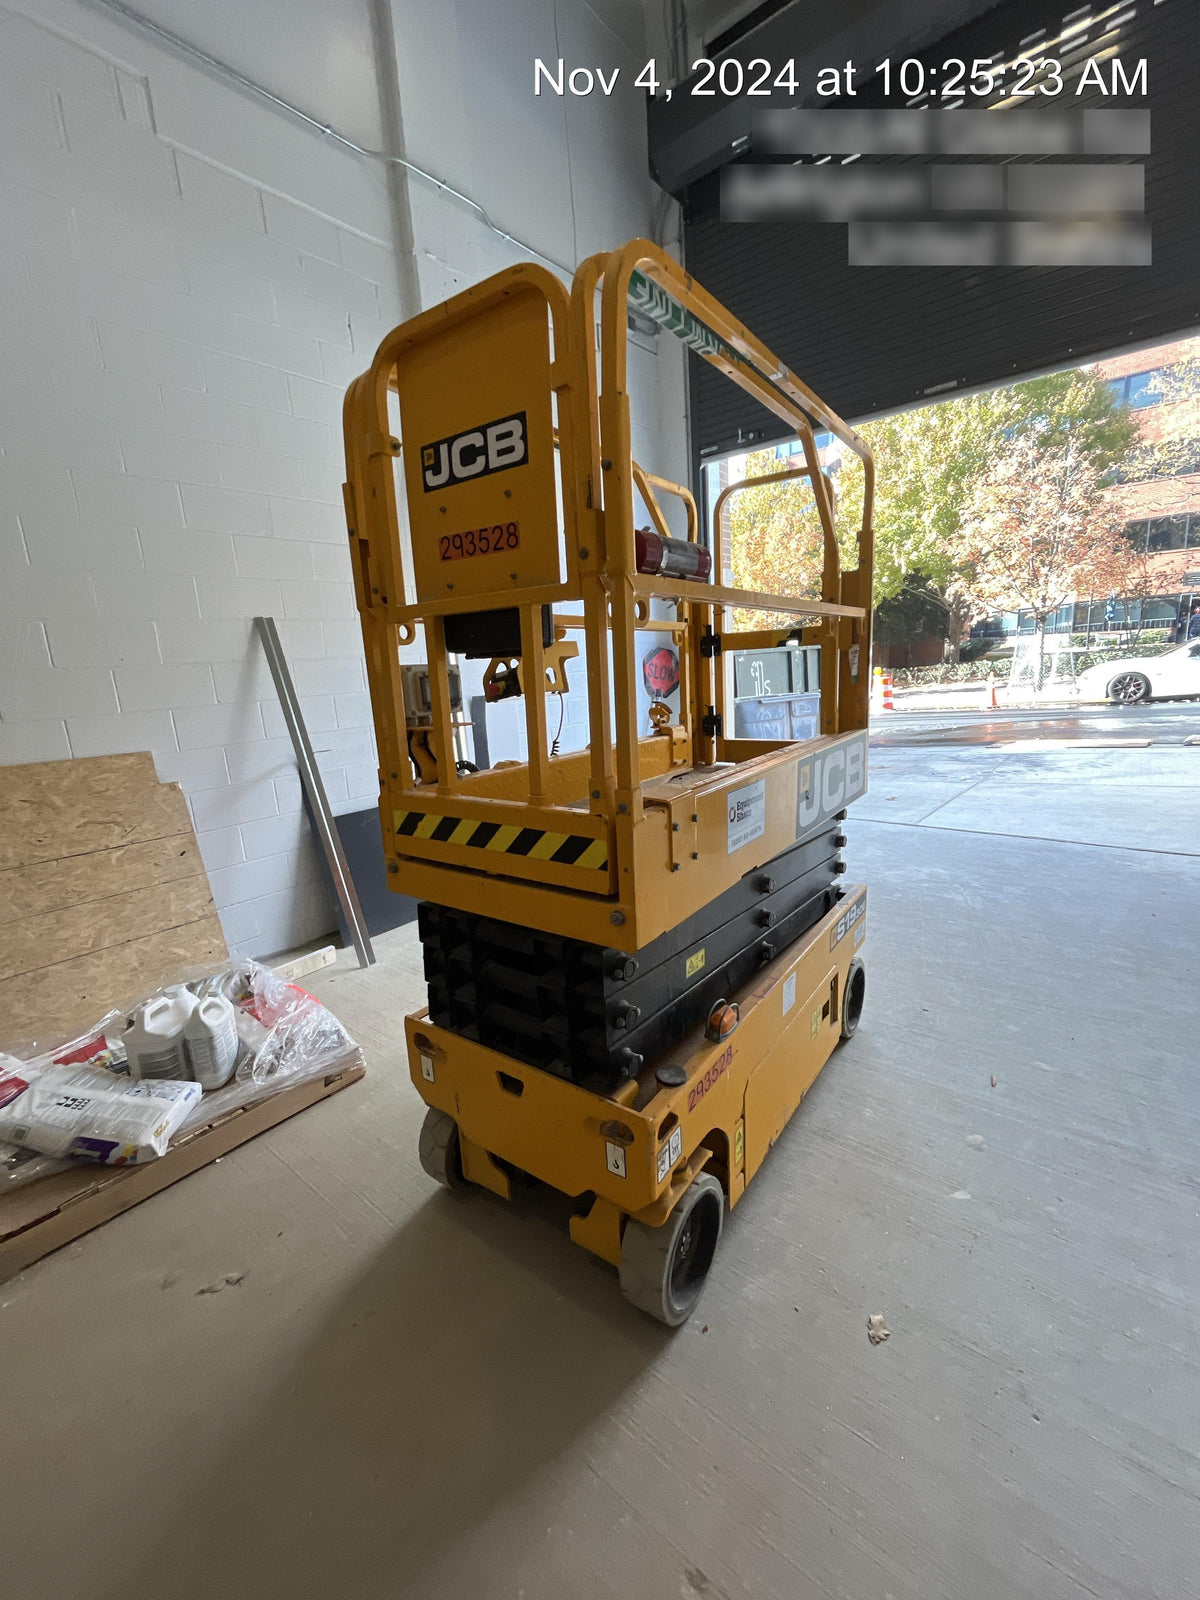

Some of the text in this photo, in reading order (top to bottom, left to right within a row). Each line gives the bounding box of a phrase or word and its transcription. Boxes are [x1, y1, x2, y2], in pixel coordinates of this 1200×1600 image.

[424, 418, 525, 488] JCB
[440, 521, 519, 561] 293528
[648, 662, 677, 683] SLOW
[798, 741, 865, 828] JCB
[688, 1044, 733, 1113] 293528
